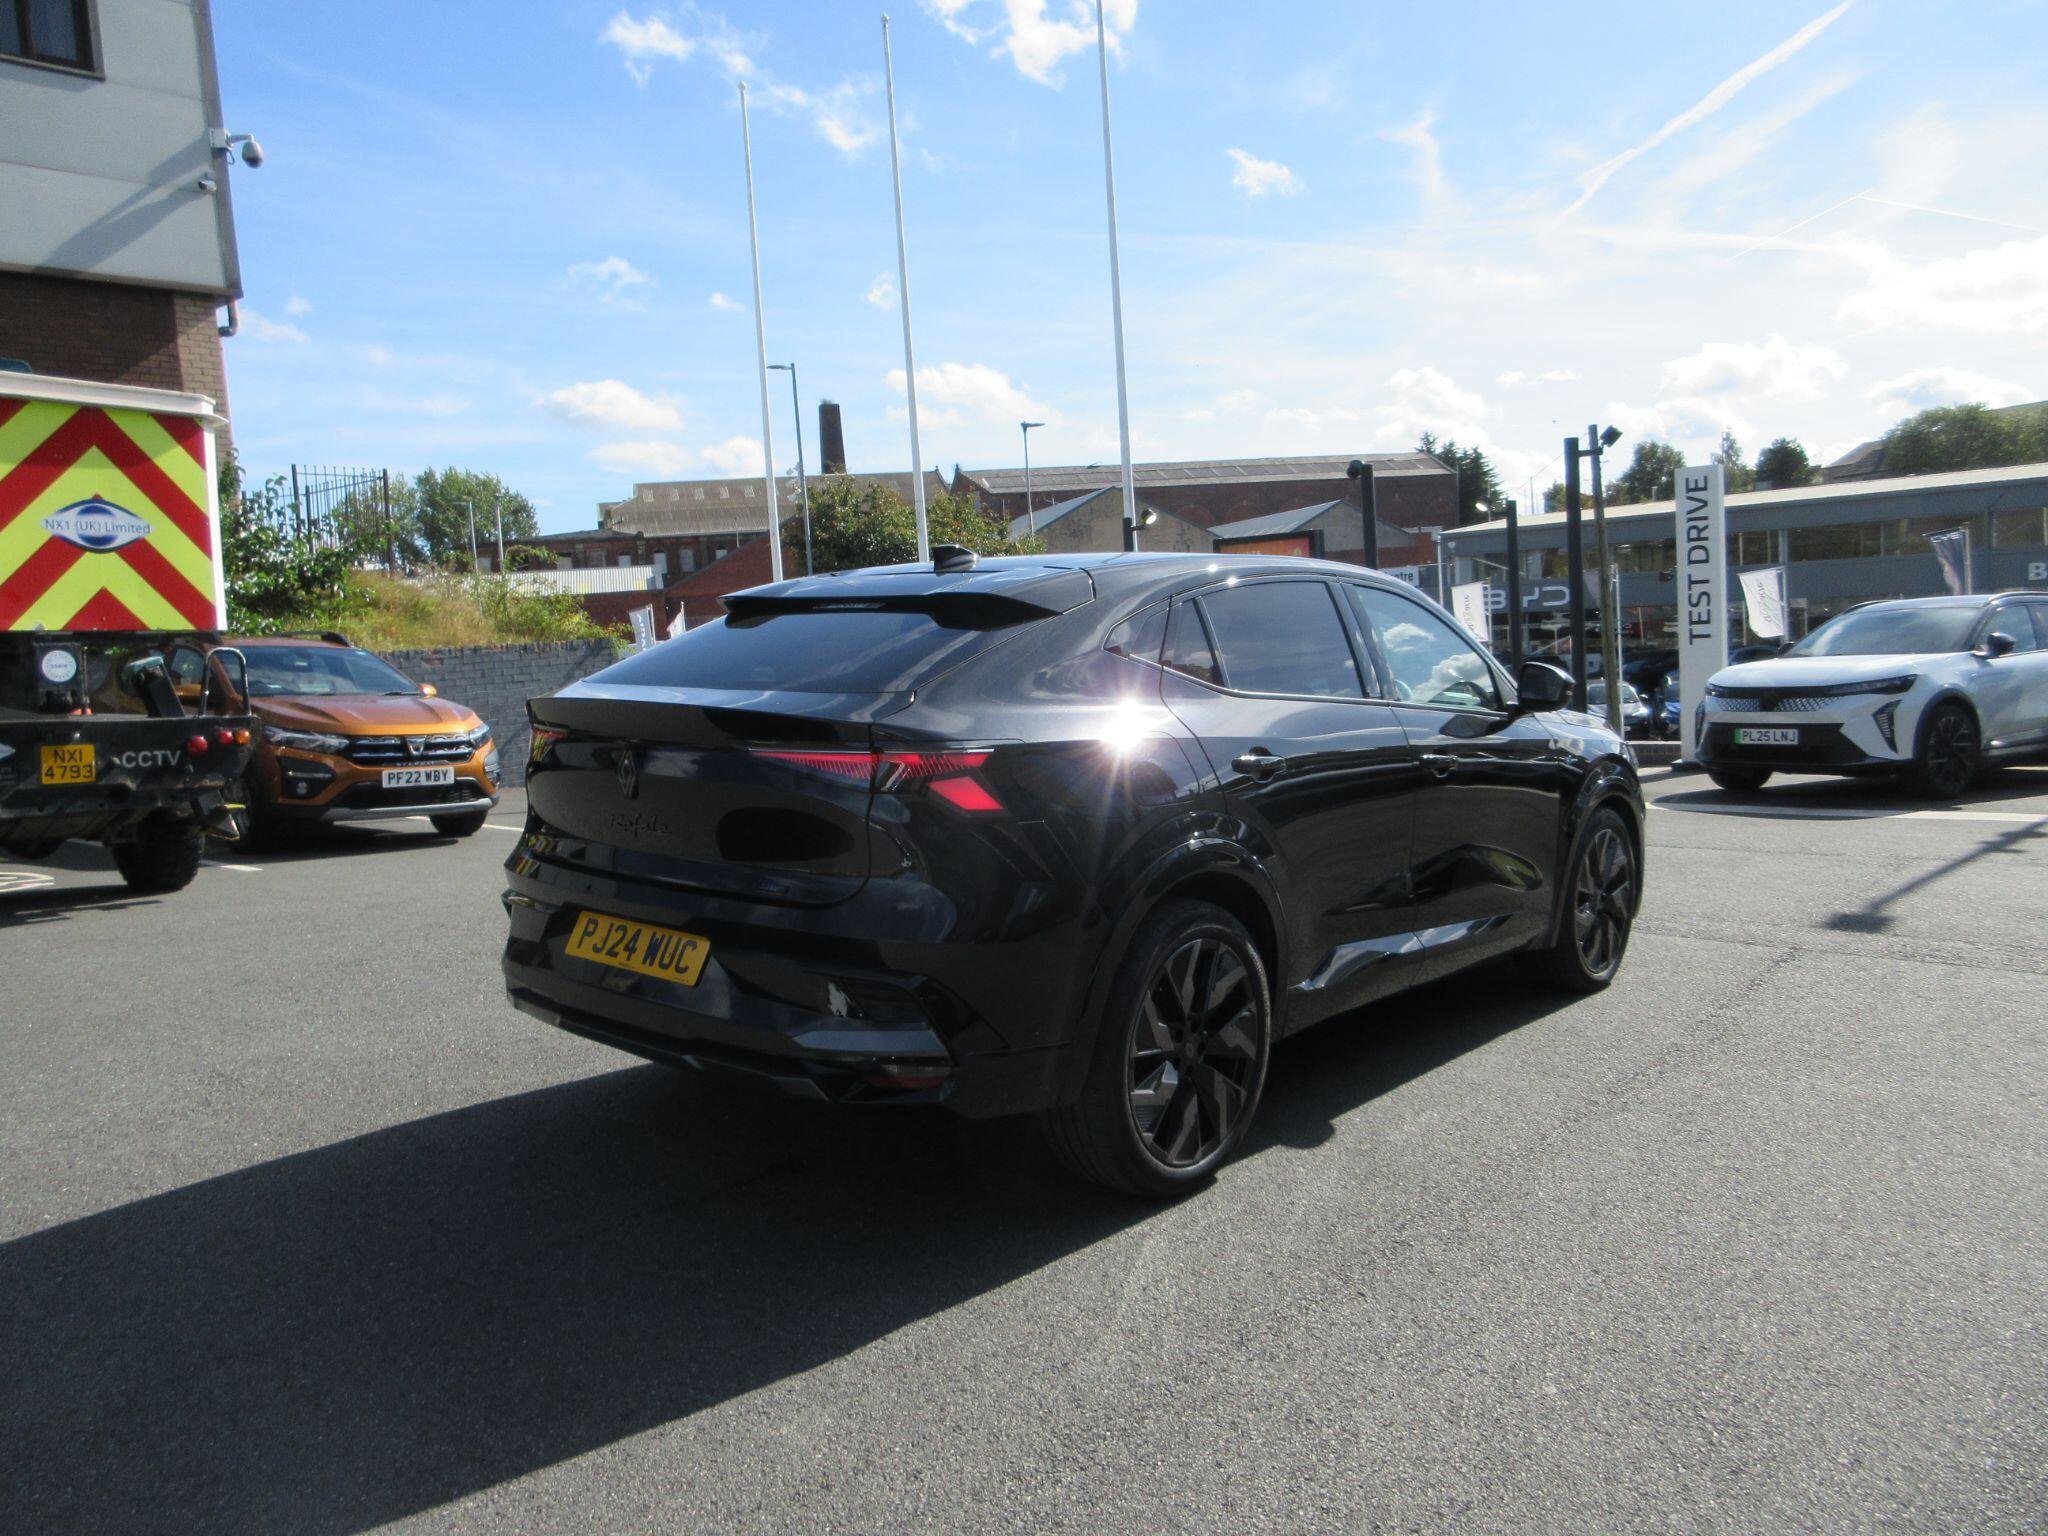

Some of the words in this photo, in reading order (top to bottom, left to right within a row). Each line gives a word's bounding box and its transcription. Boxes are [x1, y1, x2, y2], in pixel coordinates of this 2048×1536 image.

[45, 519, 70, 531] NX1
[75, 520, 101, 533] (UK)
[105, 521, 151, 534] Limited
[1685, 475, 1710, 566] DRIVE
[1688, 574, 1711, 646] TEST
[1742, 730, 1770, 742] PL25
[1773, 730, 1796, 742] LNJ
[122, 750, 181, 768] CCTV
[44, 764, 94, 780] 4793
[388, 771, 421, 785] PF22
[576, 917, 643, 962] PJ24
[642, 931, 698, 975] WUC
